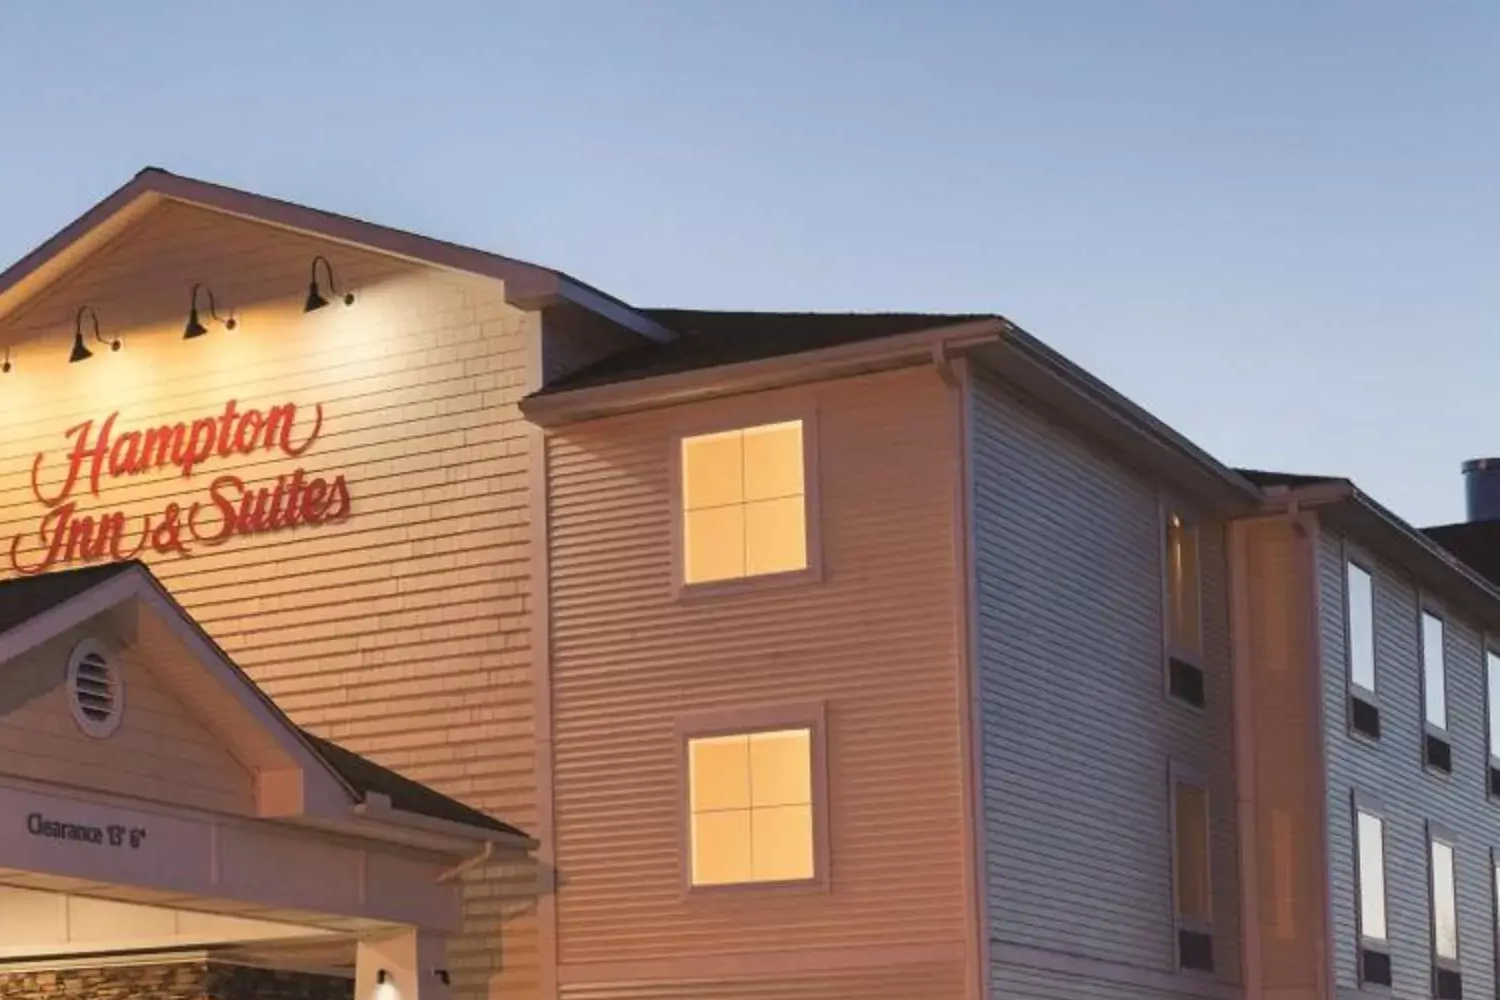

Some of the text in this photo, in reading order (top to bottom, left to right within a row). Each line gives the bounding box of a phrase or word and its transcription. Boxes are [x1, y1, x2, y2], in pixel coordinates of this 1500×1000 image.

[31, 399, 323, 508] Hampton
[10, 467, 352, 574] Inn & Suites
[27, 812, 103, 844] Clearance
